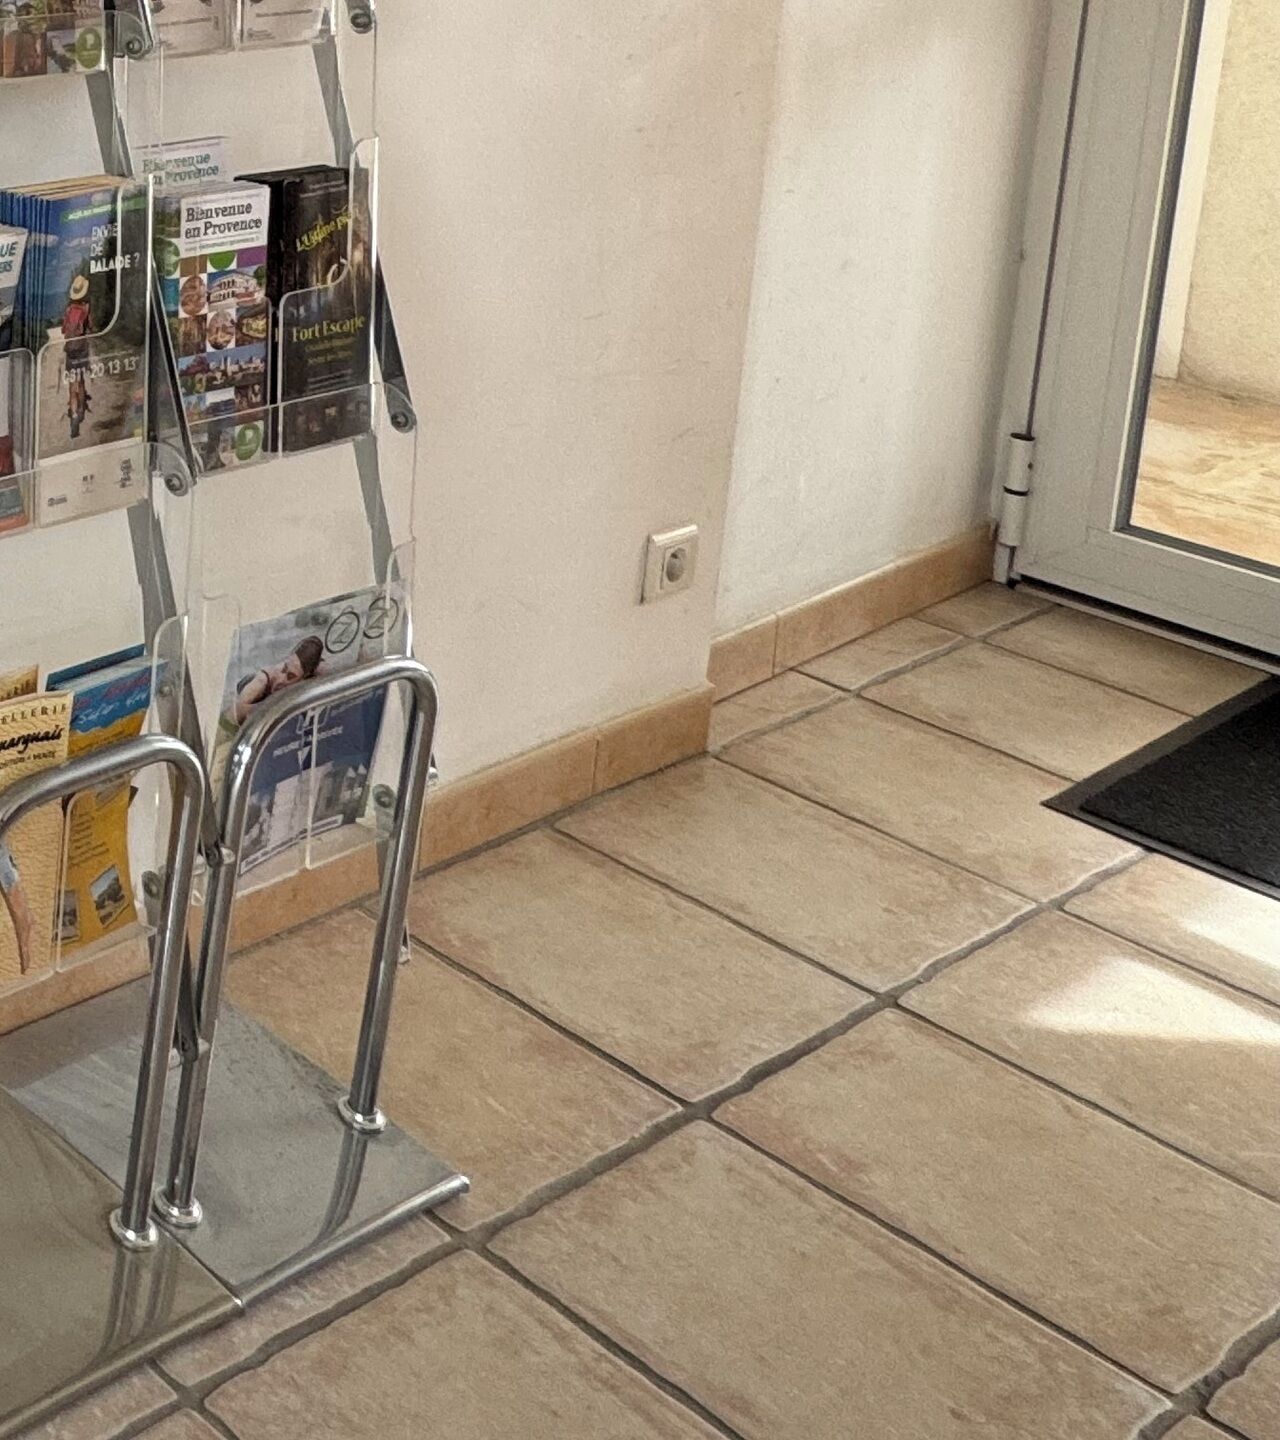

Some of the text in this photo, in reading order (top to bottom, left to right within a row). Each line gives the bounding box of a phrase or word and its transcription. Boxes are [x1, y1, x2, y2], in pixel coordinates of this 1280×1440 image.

[185, 200, 254, 223] Bienvenue
[184, 216, 264, 241] en Provence
